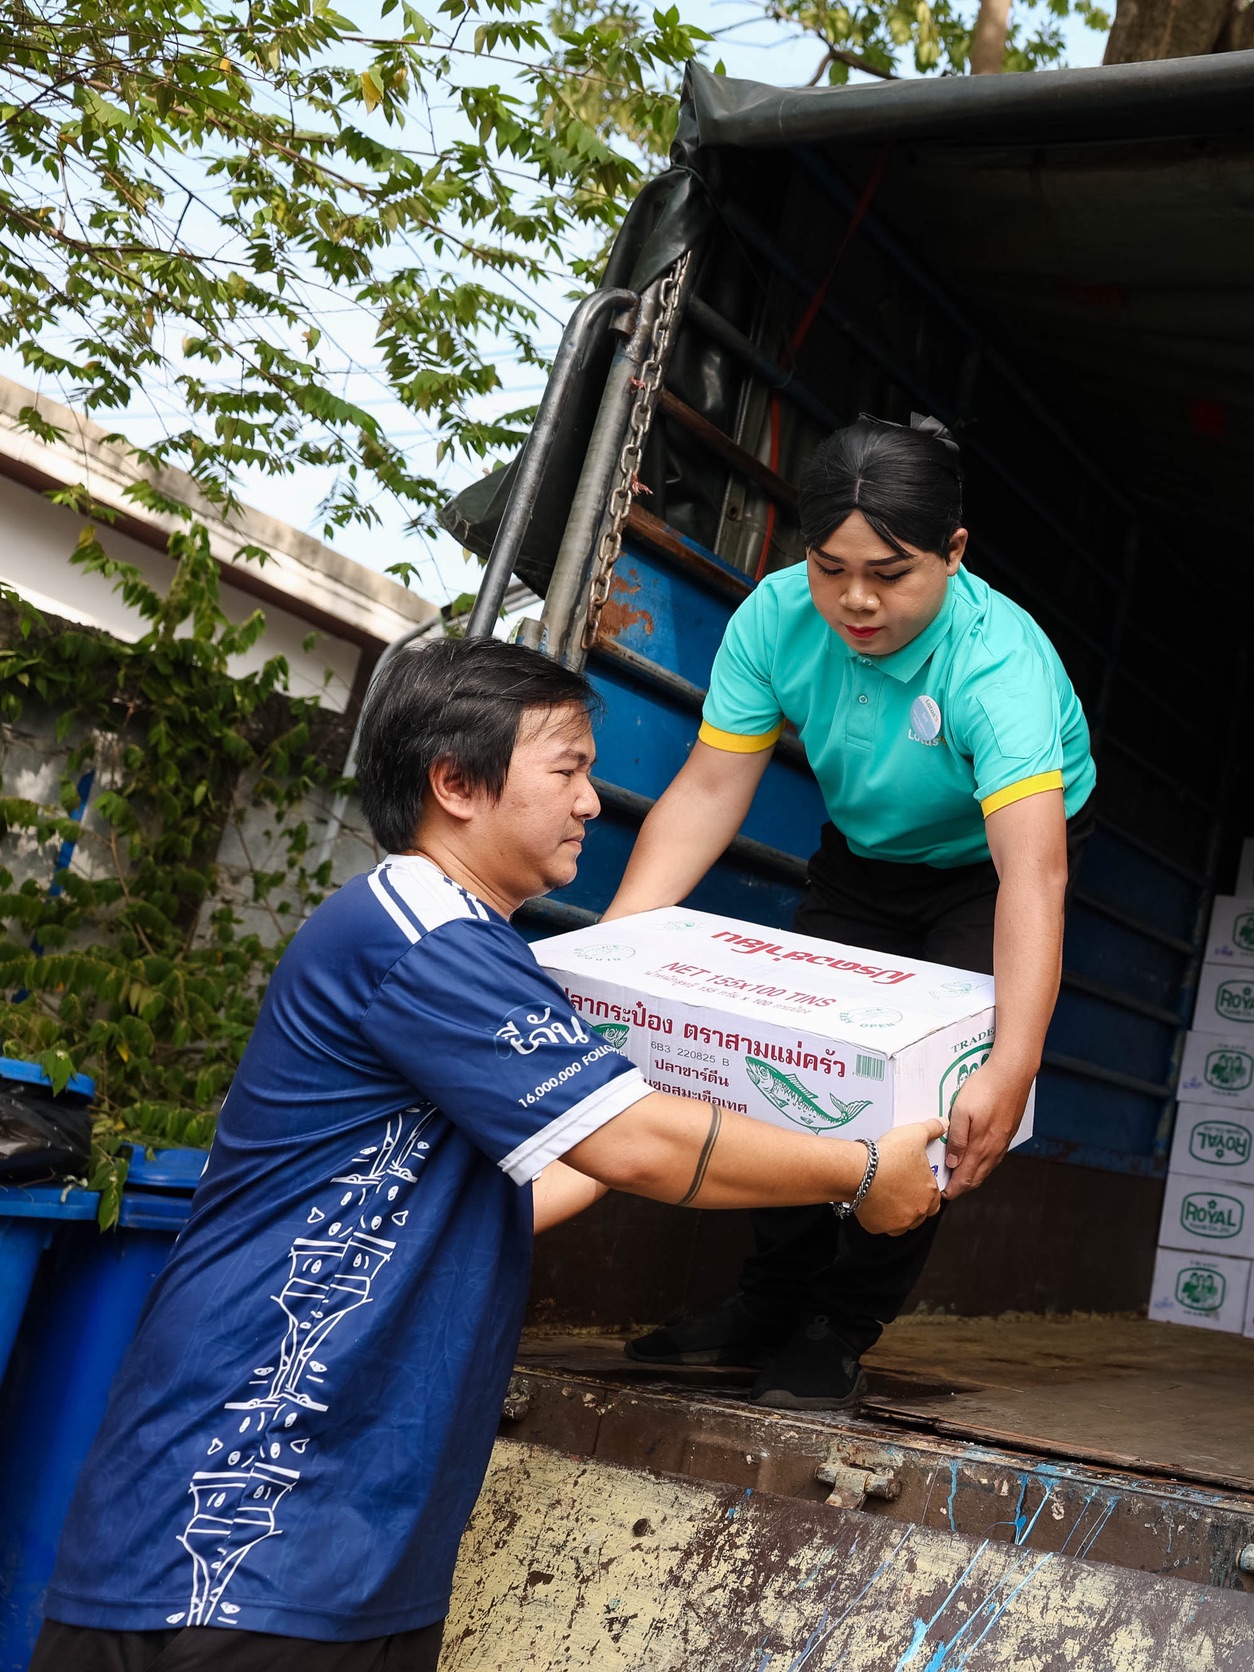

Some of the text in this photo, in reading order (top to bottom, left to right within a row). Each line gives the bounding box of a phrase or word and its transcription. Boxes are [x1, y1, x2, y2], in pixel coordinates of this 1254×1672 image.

[711, 931, 917, 985] โปรดอย่าโยน
[661, 962, 837, 1008] NET 155x100 TINS
[650, 1041, 730, 1067] 6B3 220825 B
[683, 1023, 846, 1078] ตราสามแม่ครัว
[951, 1027, 995, 1053] TRADE
[518, 1062, 582, 1108] 16,000,000
[1197, 1132, 1247, 1157] ROYAL
[1185, 1201, 1237, 1227] ROYAL
